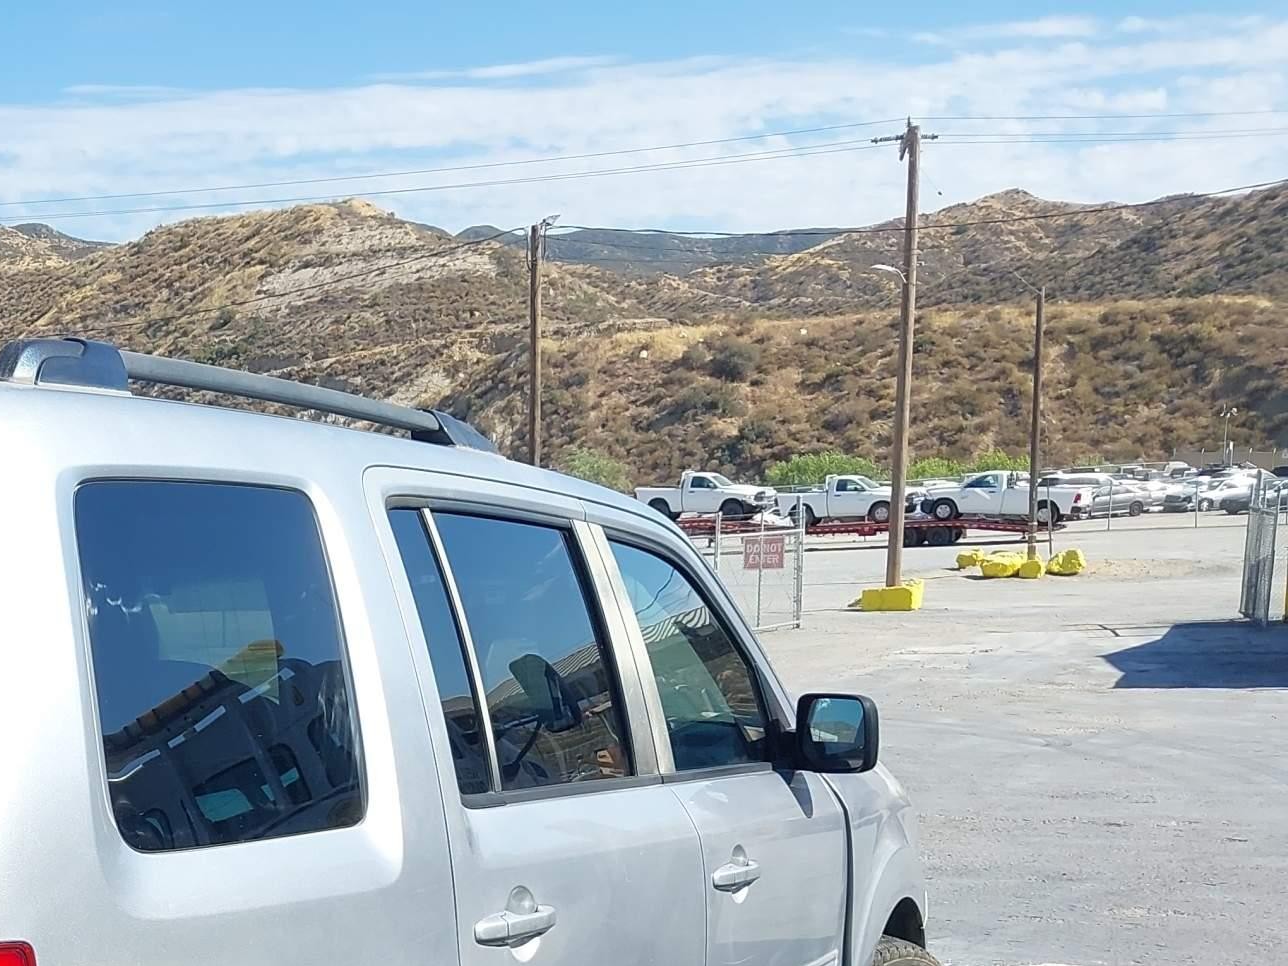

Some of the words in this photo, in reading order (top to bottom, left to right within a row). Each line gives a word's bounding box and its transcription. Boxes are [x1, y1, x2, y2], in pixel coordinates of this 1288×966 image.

[746, 543, 760, 553] DO
[763, 543, 782, 553] NOT
[749, 554, 779, 564] ENTER
